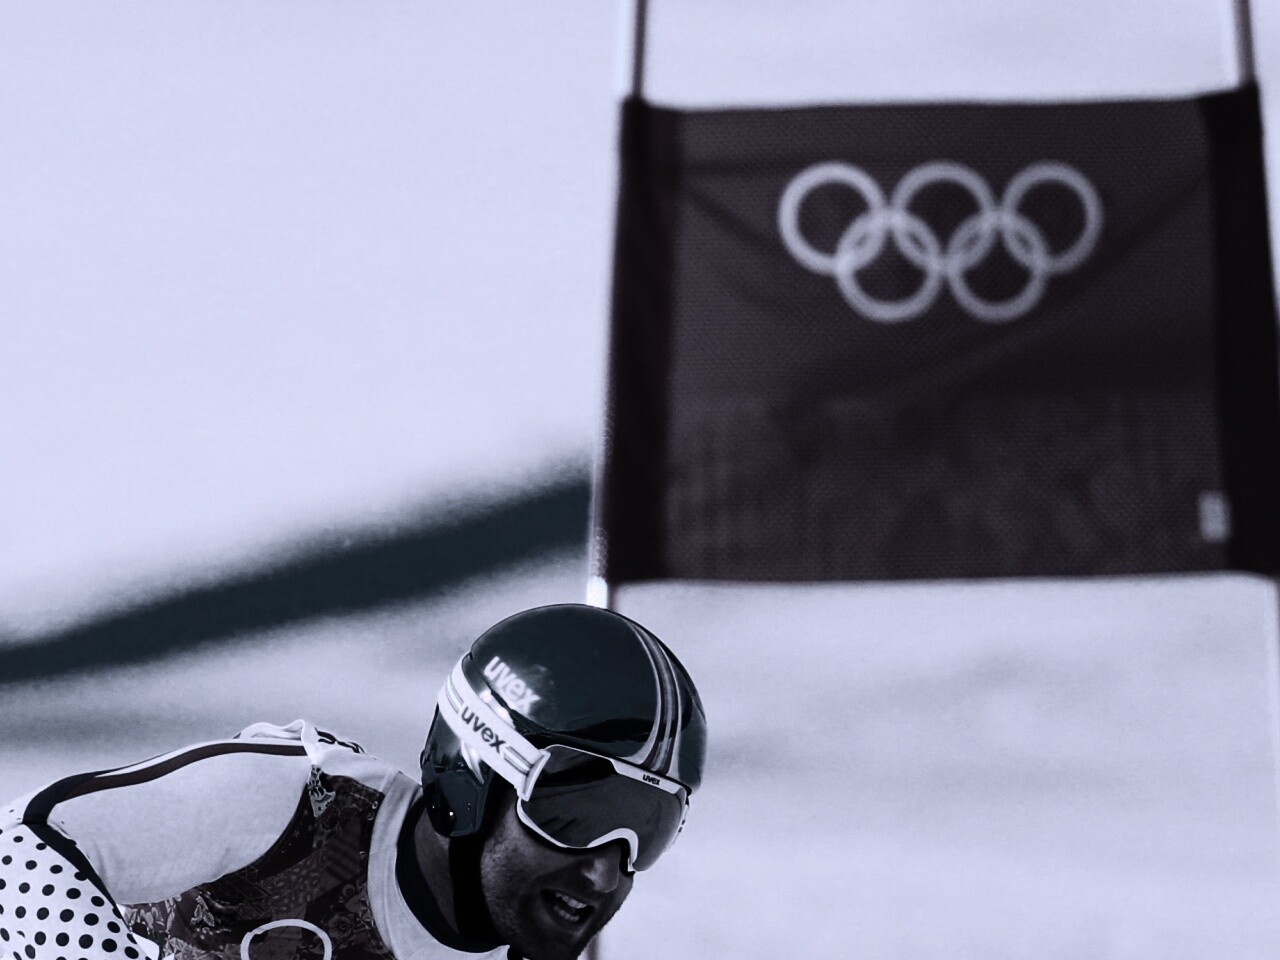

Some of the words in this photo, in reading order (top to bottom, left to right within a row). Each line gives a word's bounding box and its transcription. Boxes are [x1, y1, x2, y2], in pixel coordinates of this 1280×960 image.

[484, 656, 540, 715] uvex
[461, 706, 506, 753] uvex
[642, 774, 660, 786] uvex
